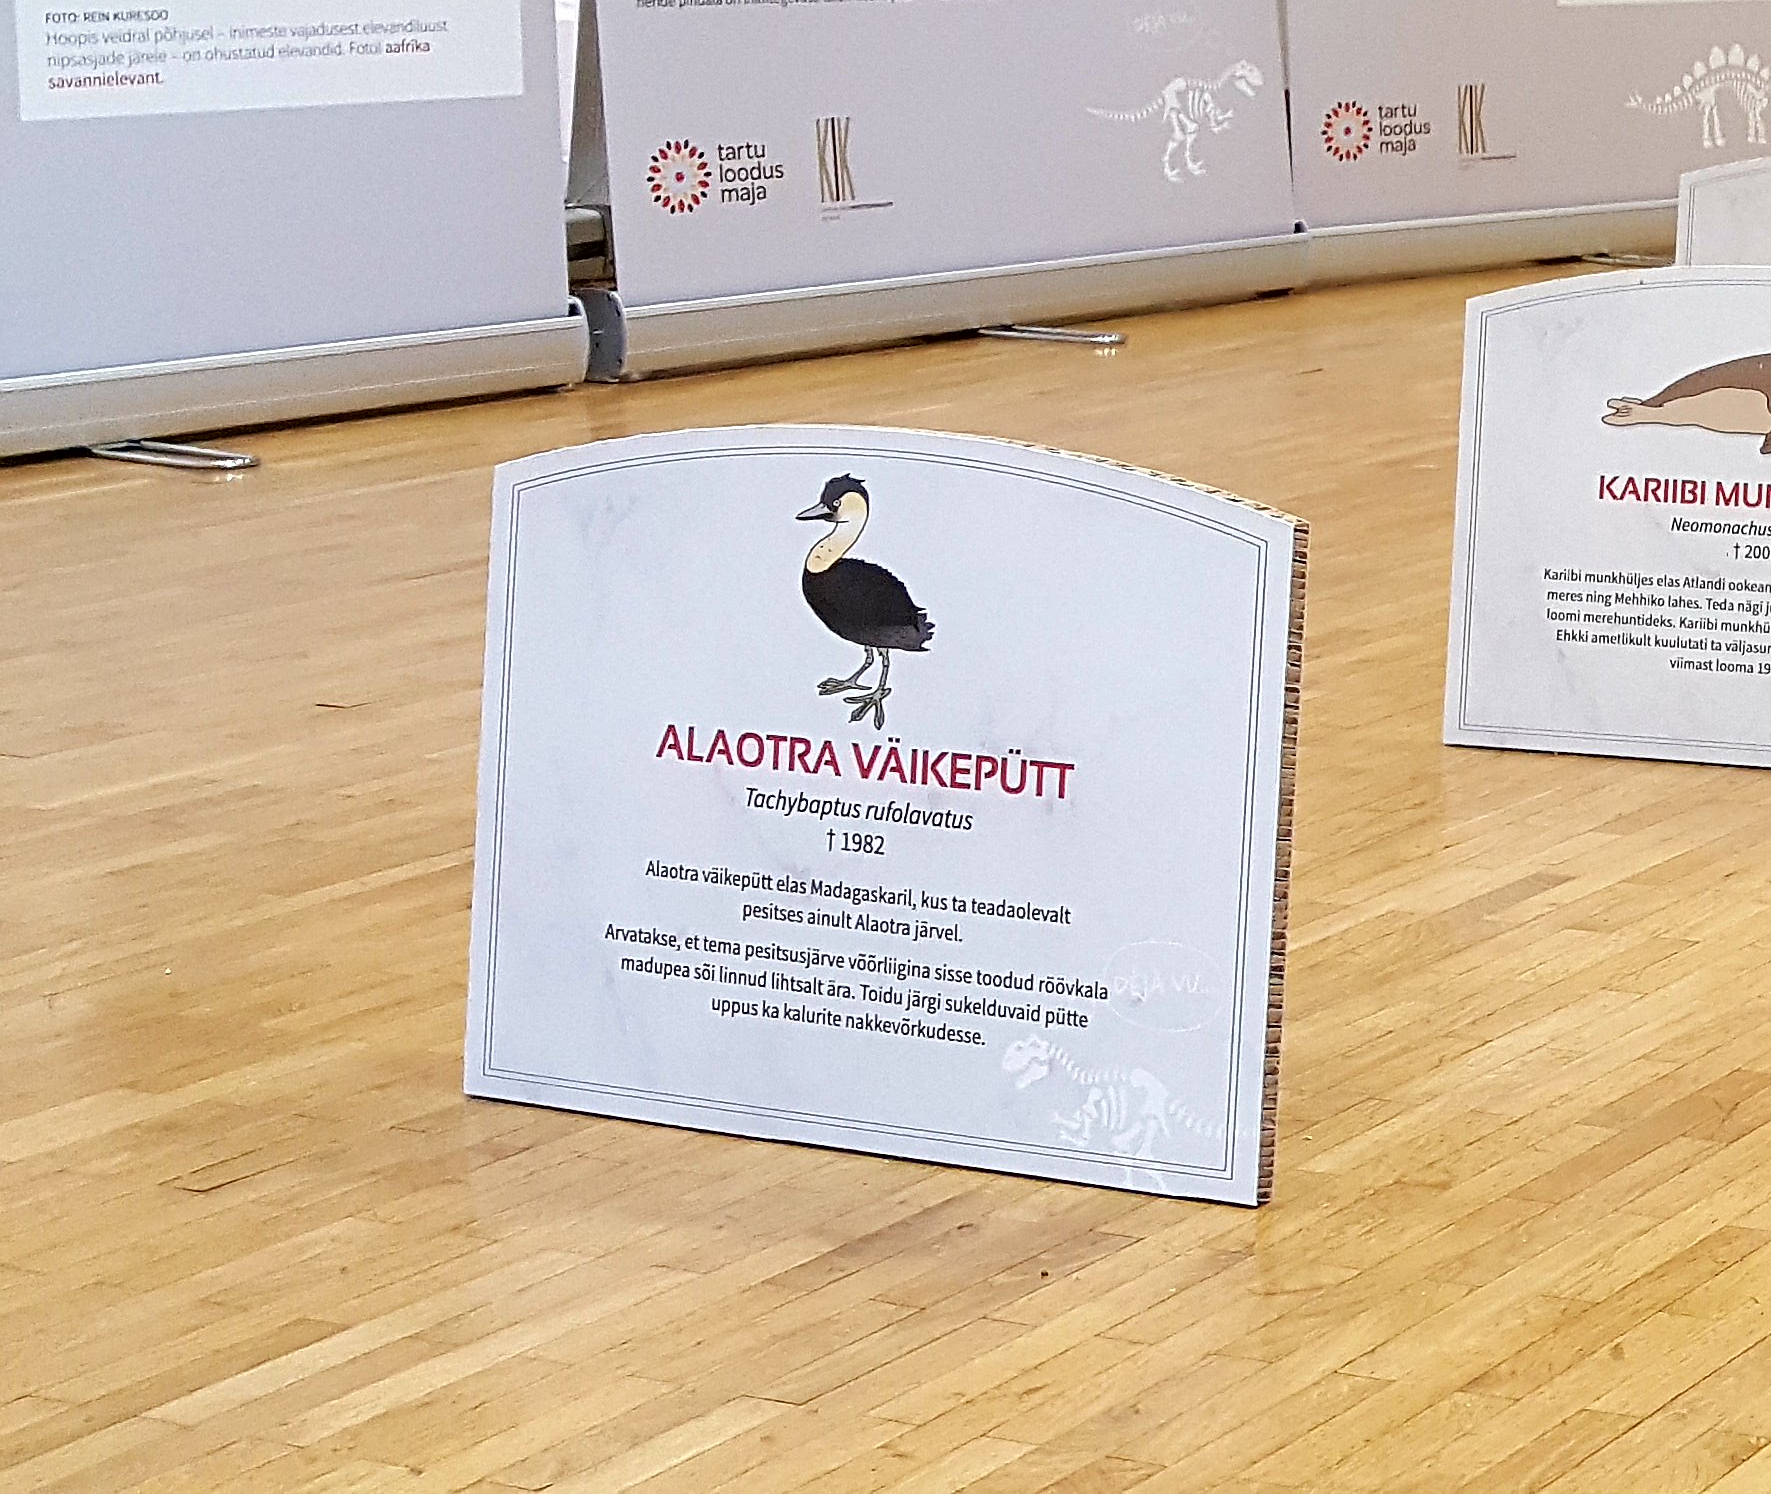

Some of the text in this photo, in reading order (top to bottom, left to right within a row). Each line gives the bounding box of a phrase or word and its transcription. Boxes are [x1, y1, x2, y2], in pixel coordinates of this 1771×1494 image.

[1377, 103, 1417, 121] tartu
[1378, 120, 1431, 137] loodus
[716, 141, 766, 162] tartu
[1379, 138, 1417, 156] maja
[718, 163, 785, 183] loodus
[720, 181, 767, 207] maja
[1598, 474, 1707, 506] KARIIBI
[1543, 567, 1582, 583] Kariibi
[1584, 570, 1654, 590] munkhüljes
[1656, 573, 1681, 588] elas
[1682, 575, 1726, 591] Atlandi
[655, 723, 1075, 800] ALAOTRA VÄIKEPÜTT
[745, 786, 974, 831] Tachybaptus rufolavatus
[840, 831, 886, 856] 1982
[644, 859, 1072, 925] Alaotra väikepütt elas Madagaskaril, kus ta teadaolevalt
[742, 902, 964, 943] pesitses ainult Alaotra järvel.
